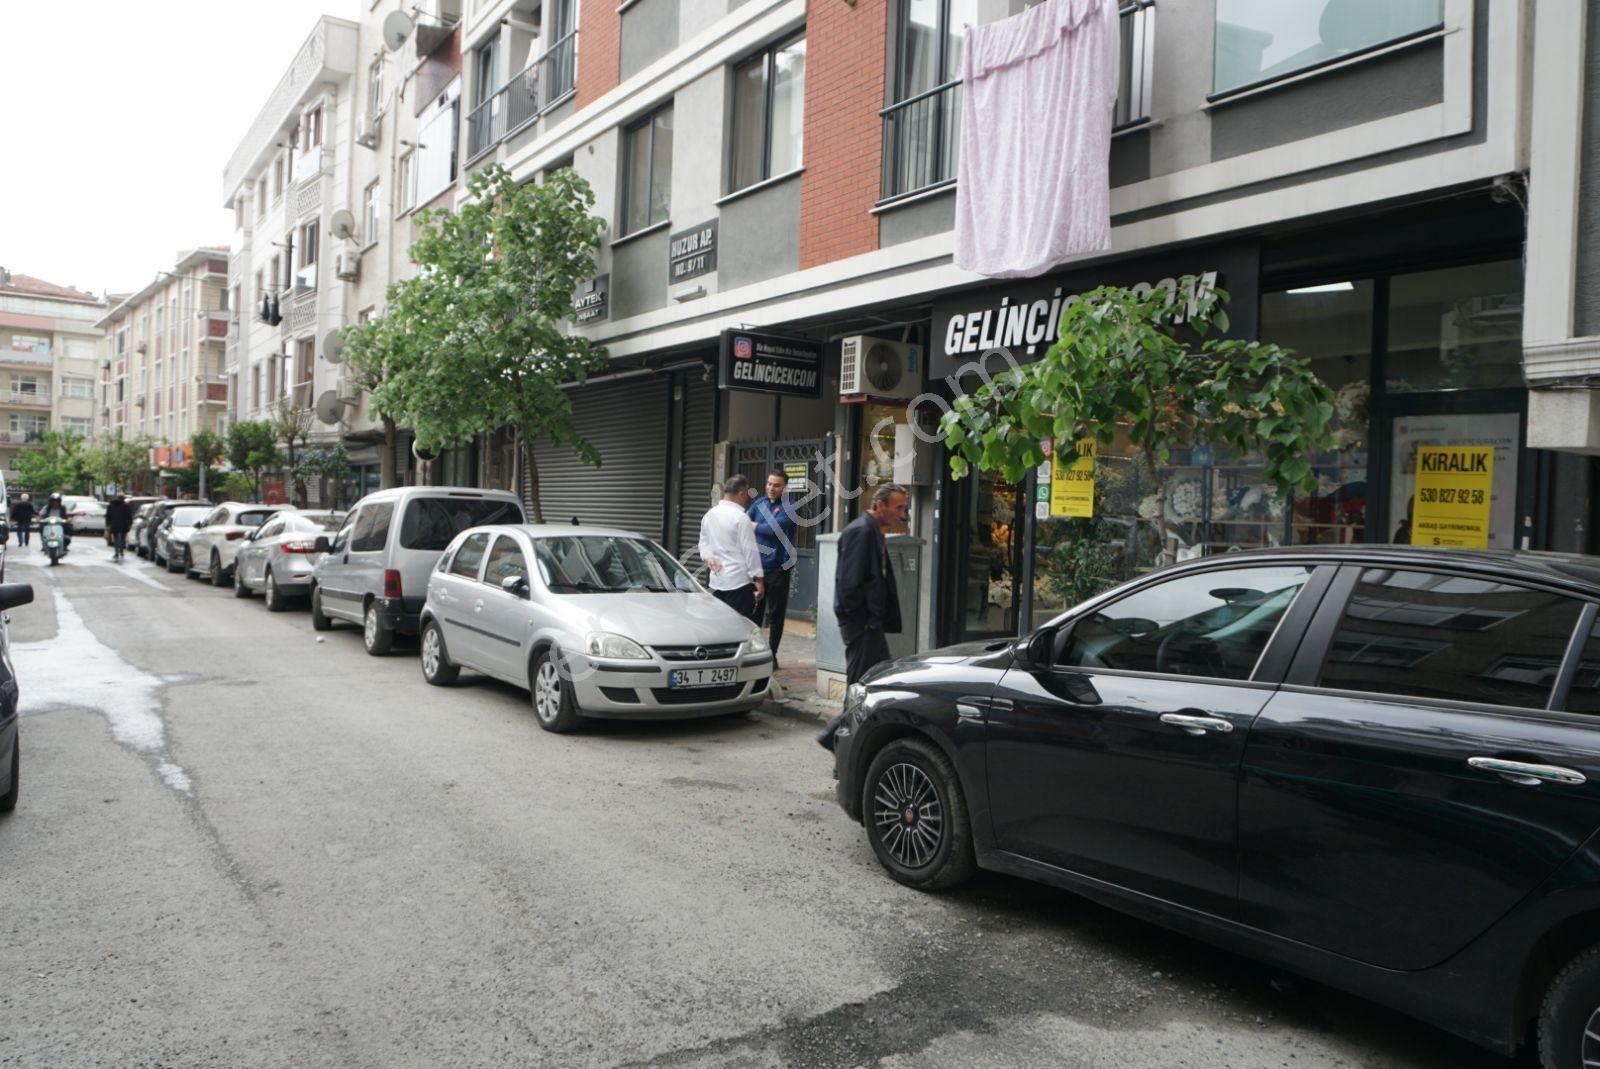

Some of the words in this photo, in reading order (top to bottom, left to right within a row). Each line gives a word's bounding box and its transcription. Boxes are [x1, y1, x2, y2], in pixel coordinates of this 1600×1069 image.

[671, 233, 699, 258] HUZUR
[699, 228, 712, 248] AP.
[574, 291, 603, 309] AYTEK
[1420, 487, 1438, 503] 530
[1439, 488, 1457, 504] 827
[1457, 488, 1470, 504] 92
[1471, 489, 1484, 505] 58
[677, 671, 690, 684] 34
[697, 670, 704, 683] T
[711, 669, 735, 682] 2497
